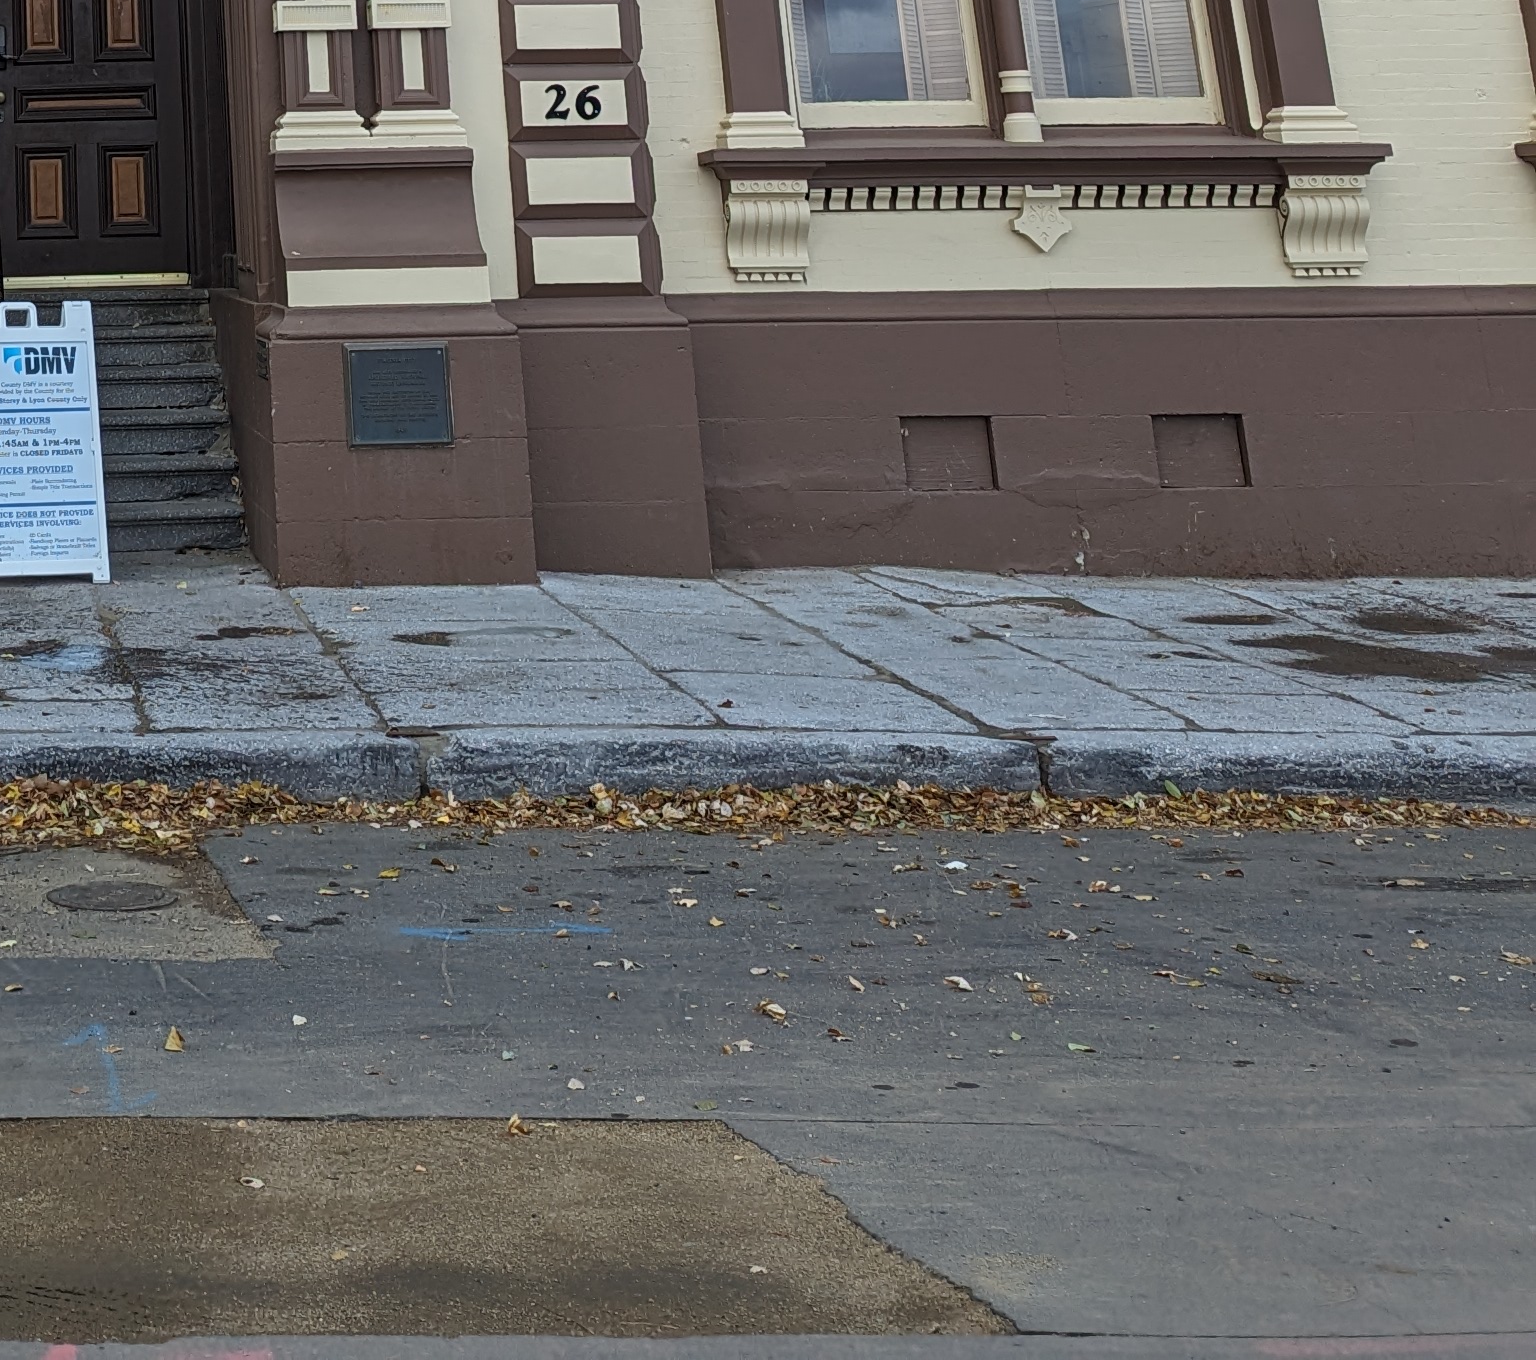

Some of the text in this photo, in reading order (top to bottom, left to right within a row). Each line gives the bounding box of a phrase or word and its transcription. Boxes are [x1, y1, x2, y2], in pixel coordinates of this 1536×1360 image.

[545, 84, 601, 120] 26
[24, 347, 76, 375] DMV
[27, 465, 73, 474] PROVIDED
[40, 510, 56, 518] NOT
